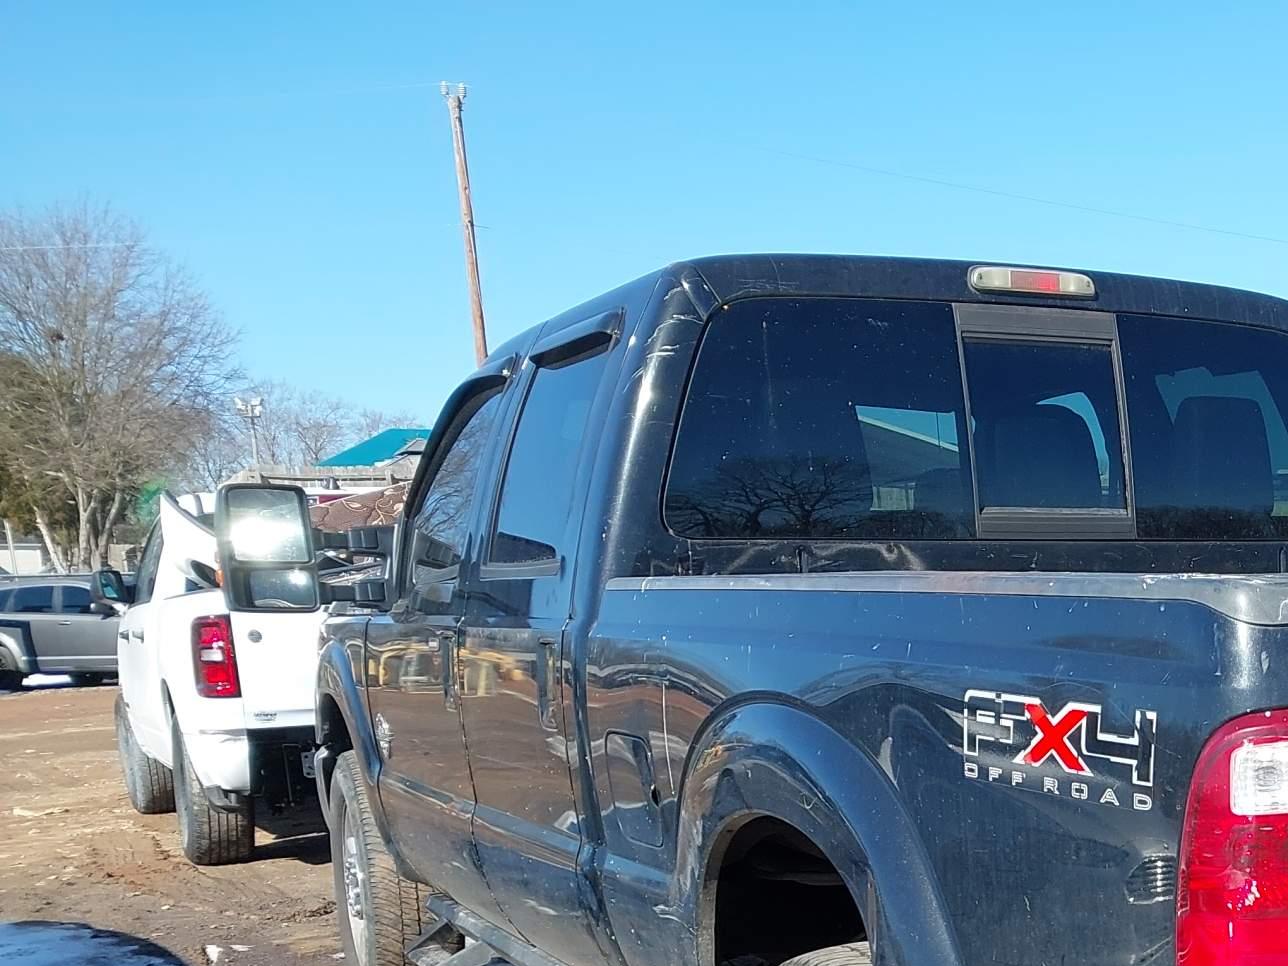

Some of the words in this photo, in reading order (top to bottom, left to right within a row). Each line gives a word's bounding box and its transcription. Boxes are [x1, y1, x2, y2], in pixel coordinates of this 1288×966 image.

[963, 689, 1157, 787] FX4
[963, 762, 1026, 787] OFF
[1043, 776, 1153, 812] ROAD
